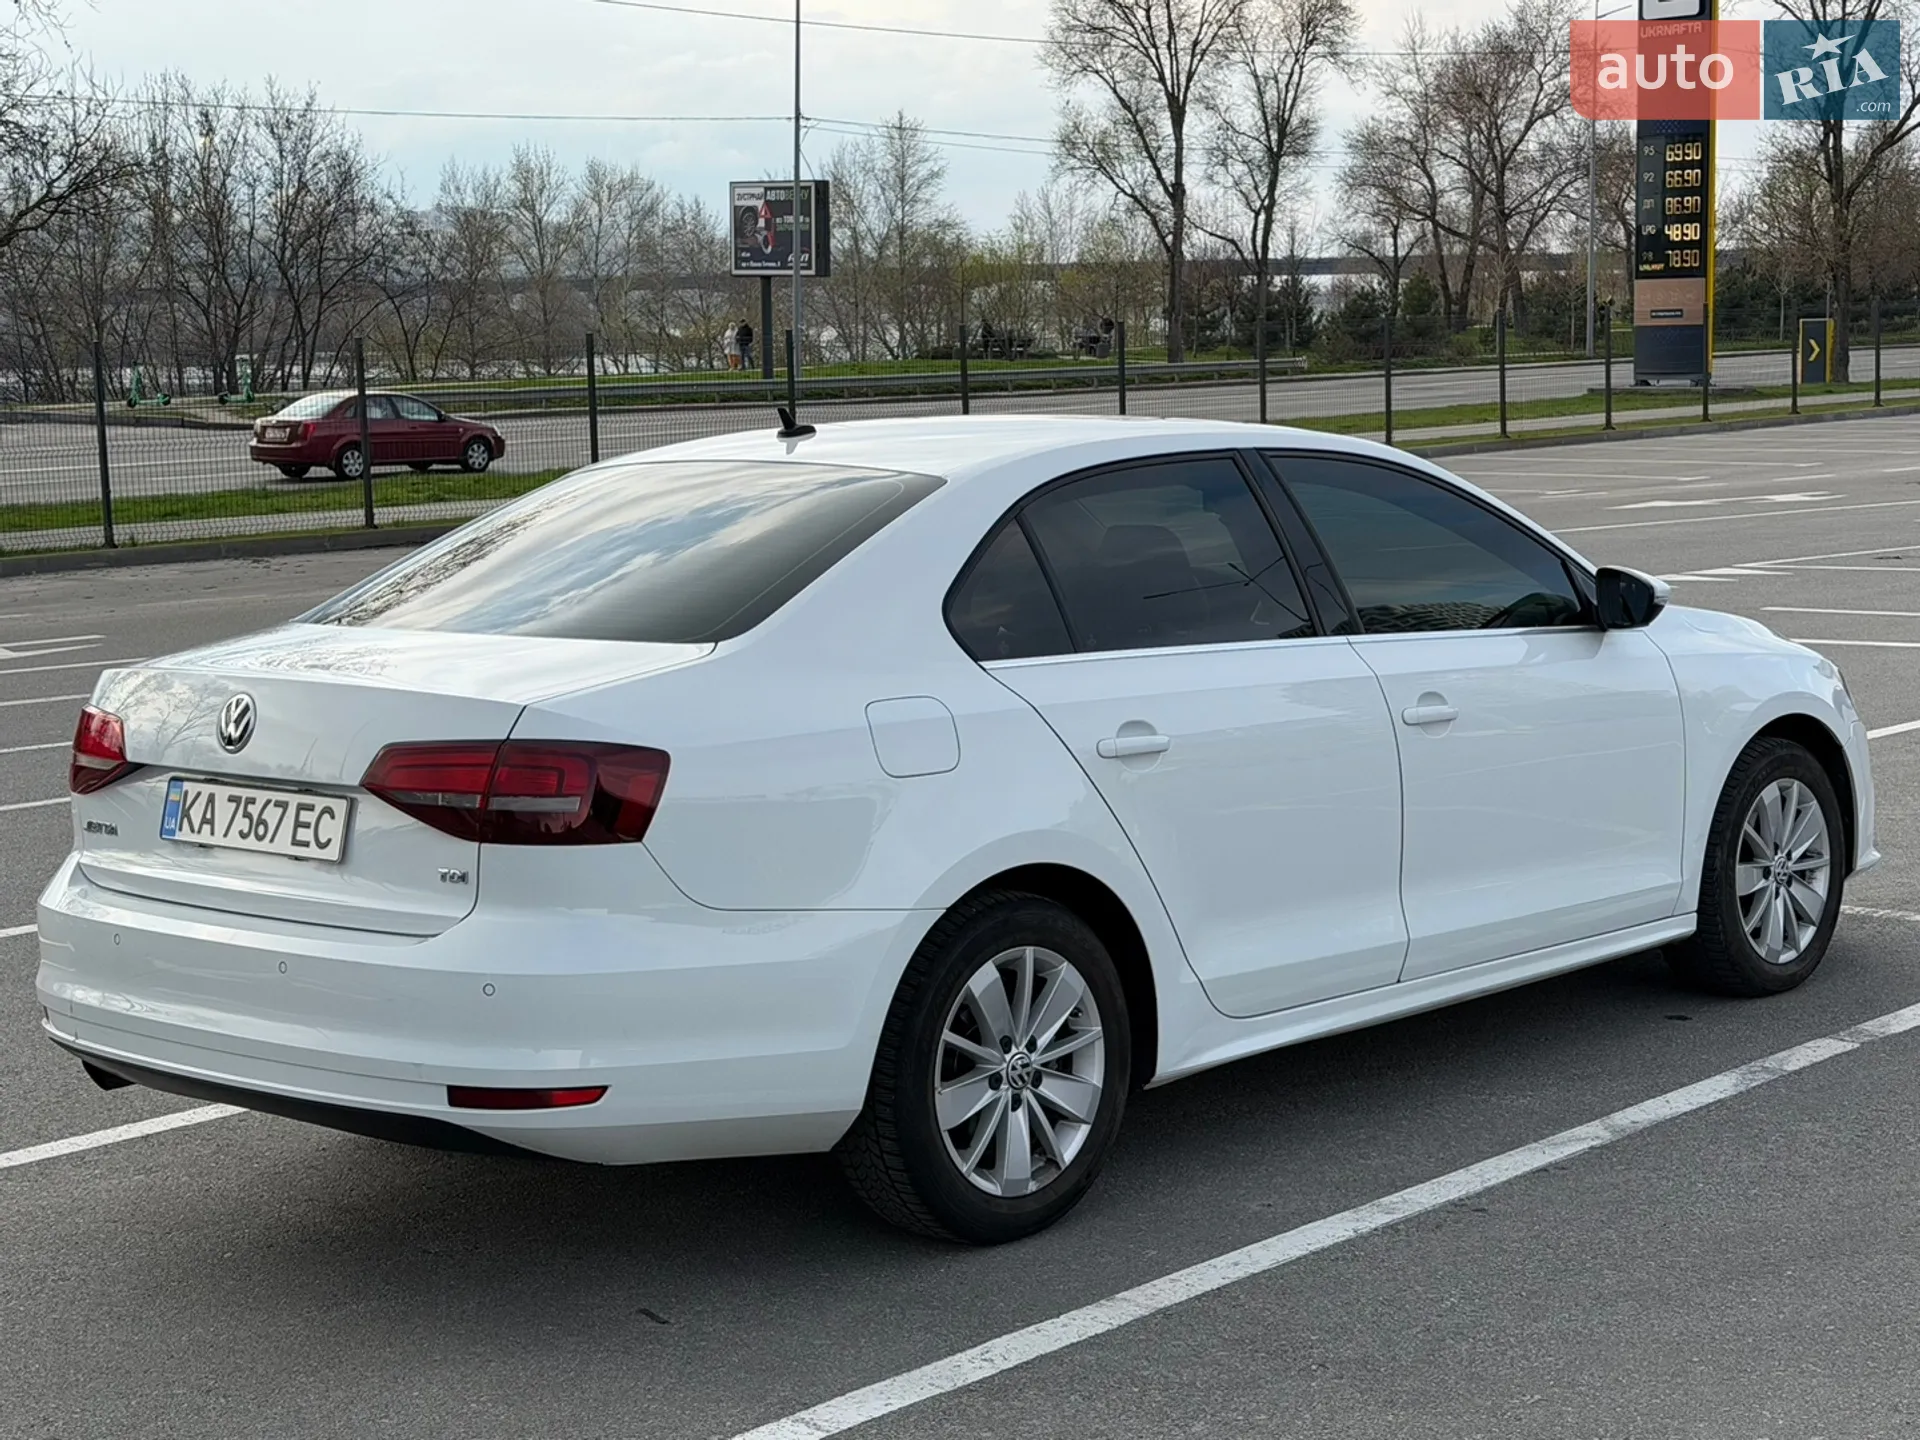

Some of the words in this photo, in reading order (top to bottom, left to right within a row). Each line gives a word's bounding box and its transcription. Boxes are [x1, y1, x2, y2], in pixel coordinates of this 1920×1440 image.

[1640, 22, 1702, 38] UKRNAFTA
[1643, 146, 1655, 156] 95
[1643, 172, 1655, 182] 92
[1641, 224, 1656, 235] LPG
[164, 816, 176, 829] UA
[178, 789, 215, 836] KA
[222, 794, 290, 844] 7567
[291, 802, 336, 850] EC
[438, 868, 469, 884] TDI
